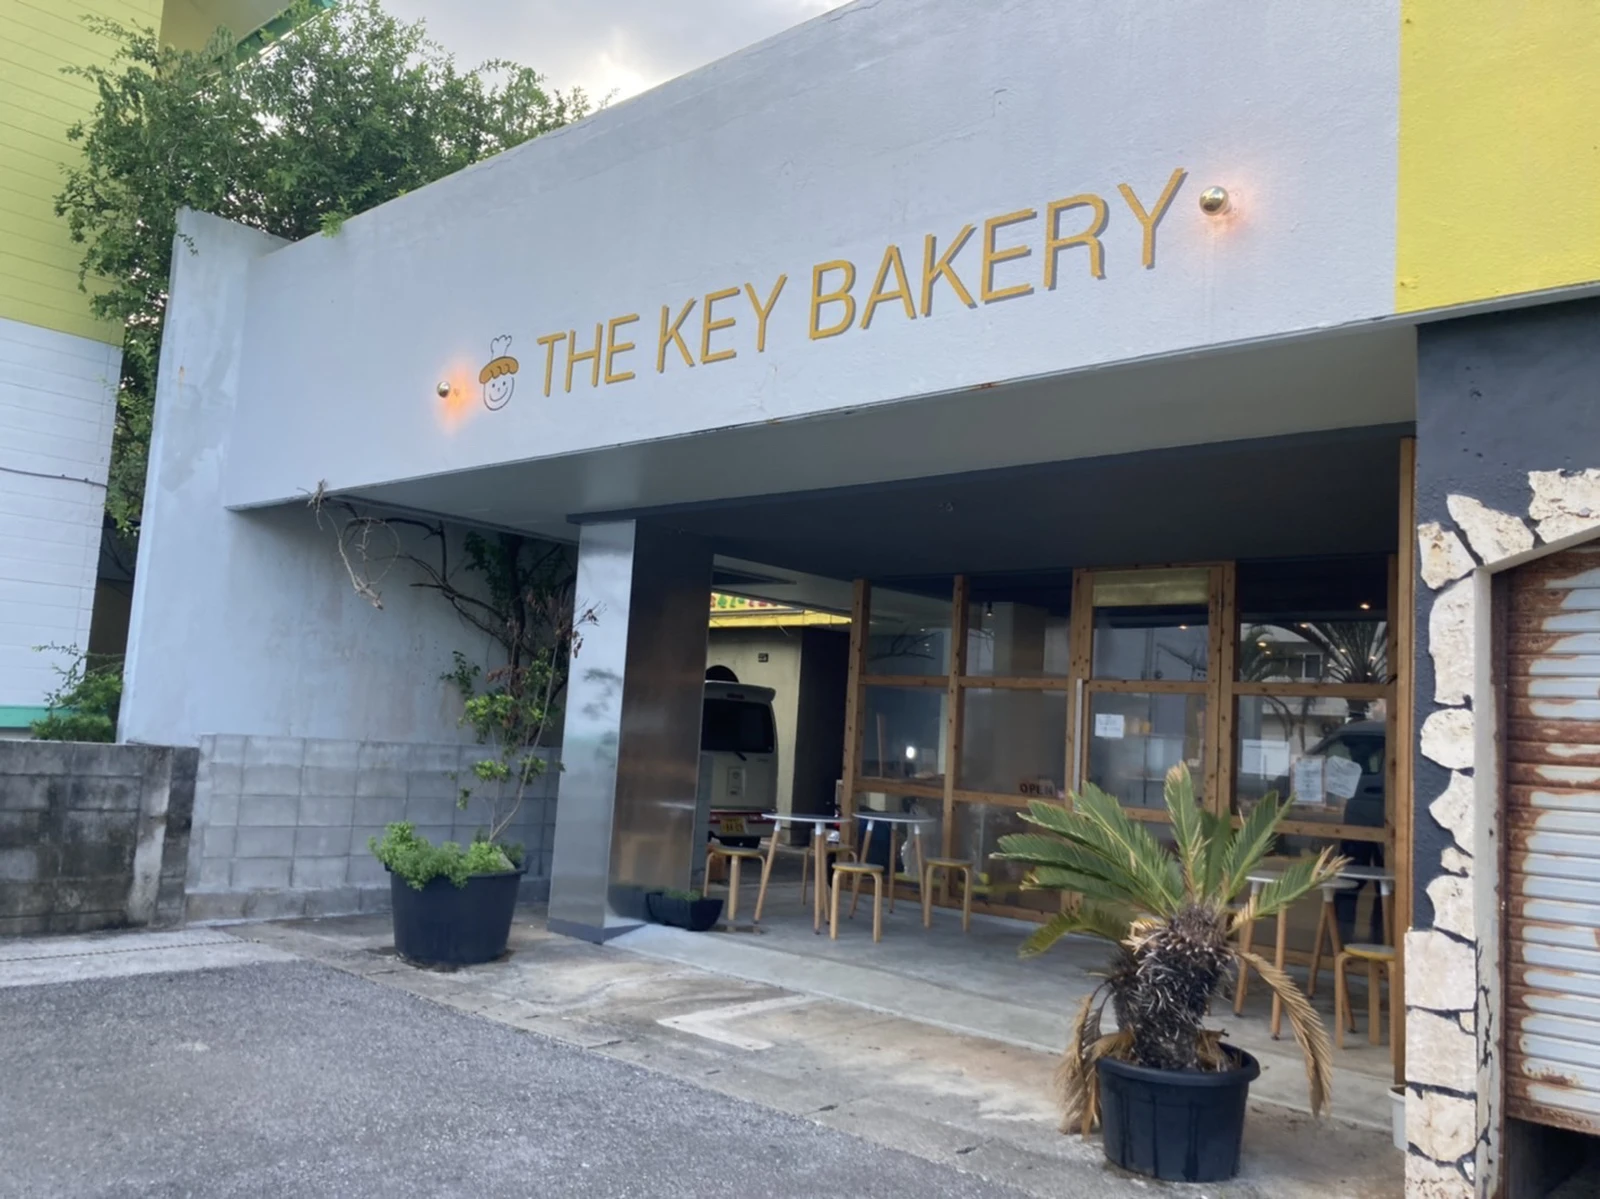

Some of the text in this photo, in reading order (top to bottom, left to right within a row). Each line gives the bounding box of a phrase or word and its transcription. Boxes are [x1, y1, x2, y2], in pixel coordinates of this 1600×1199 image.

[536, 167, 1187, 398] THE KEY BAKERY
